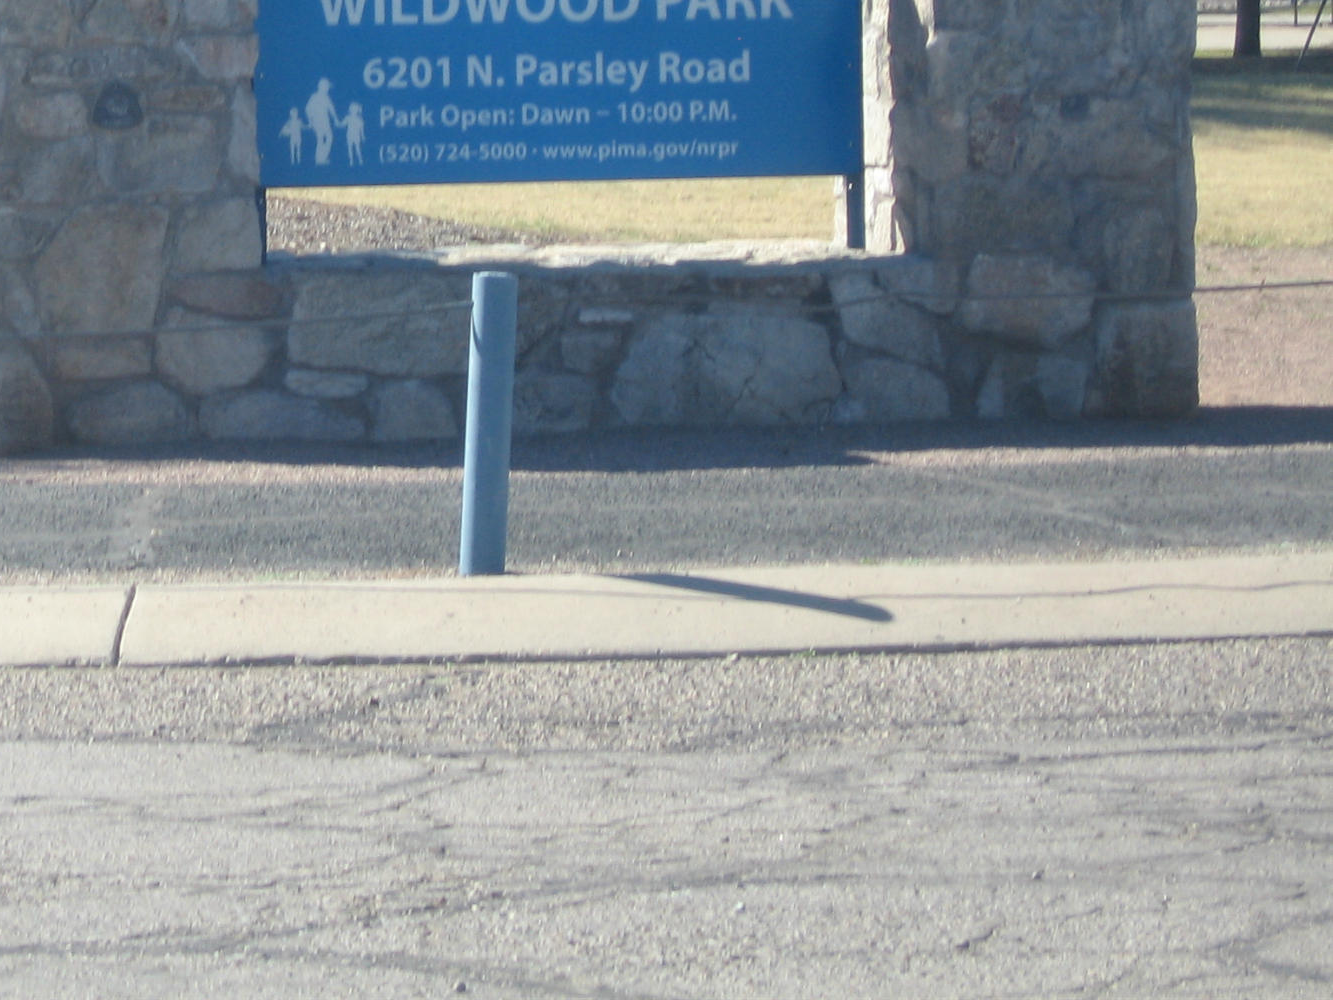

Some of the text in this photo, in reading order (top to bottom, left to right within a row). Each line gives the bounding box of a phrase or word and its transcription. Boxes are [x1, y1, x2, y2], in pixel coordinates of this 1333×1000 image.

[363, 49, 751, 92] 6201 N. Parsley Road
[380, 104, 435, 128] Park
[440, 104, 515, 132] Open:
[522, 102, 590, 124] Dawn
[618, 101, 683, 123] 10:00
[689, 100, 737, 122] P.M.
[379, 139, 739, 163] (520) 724-5000 www.pima.gov/nrpr
